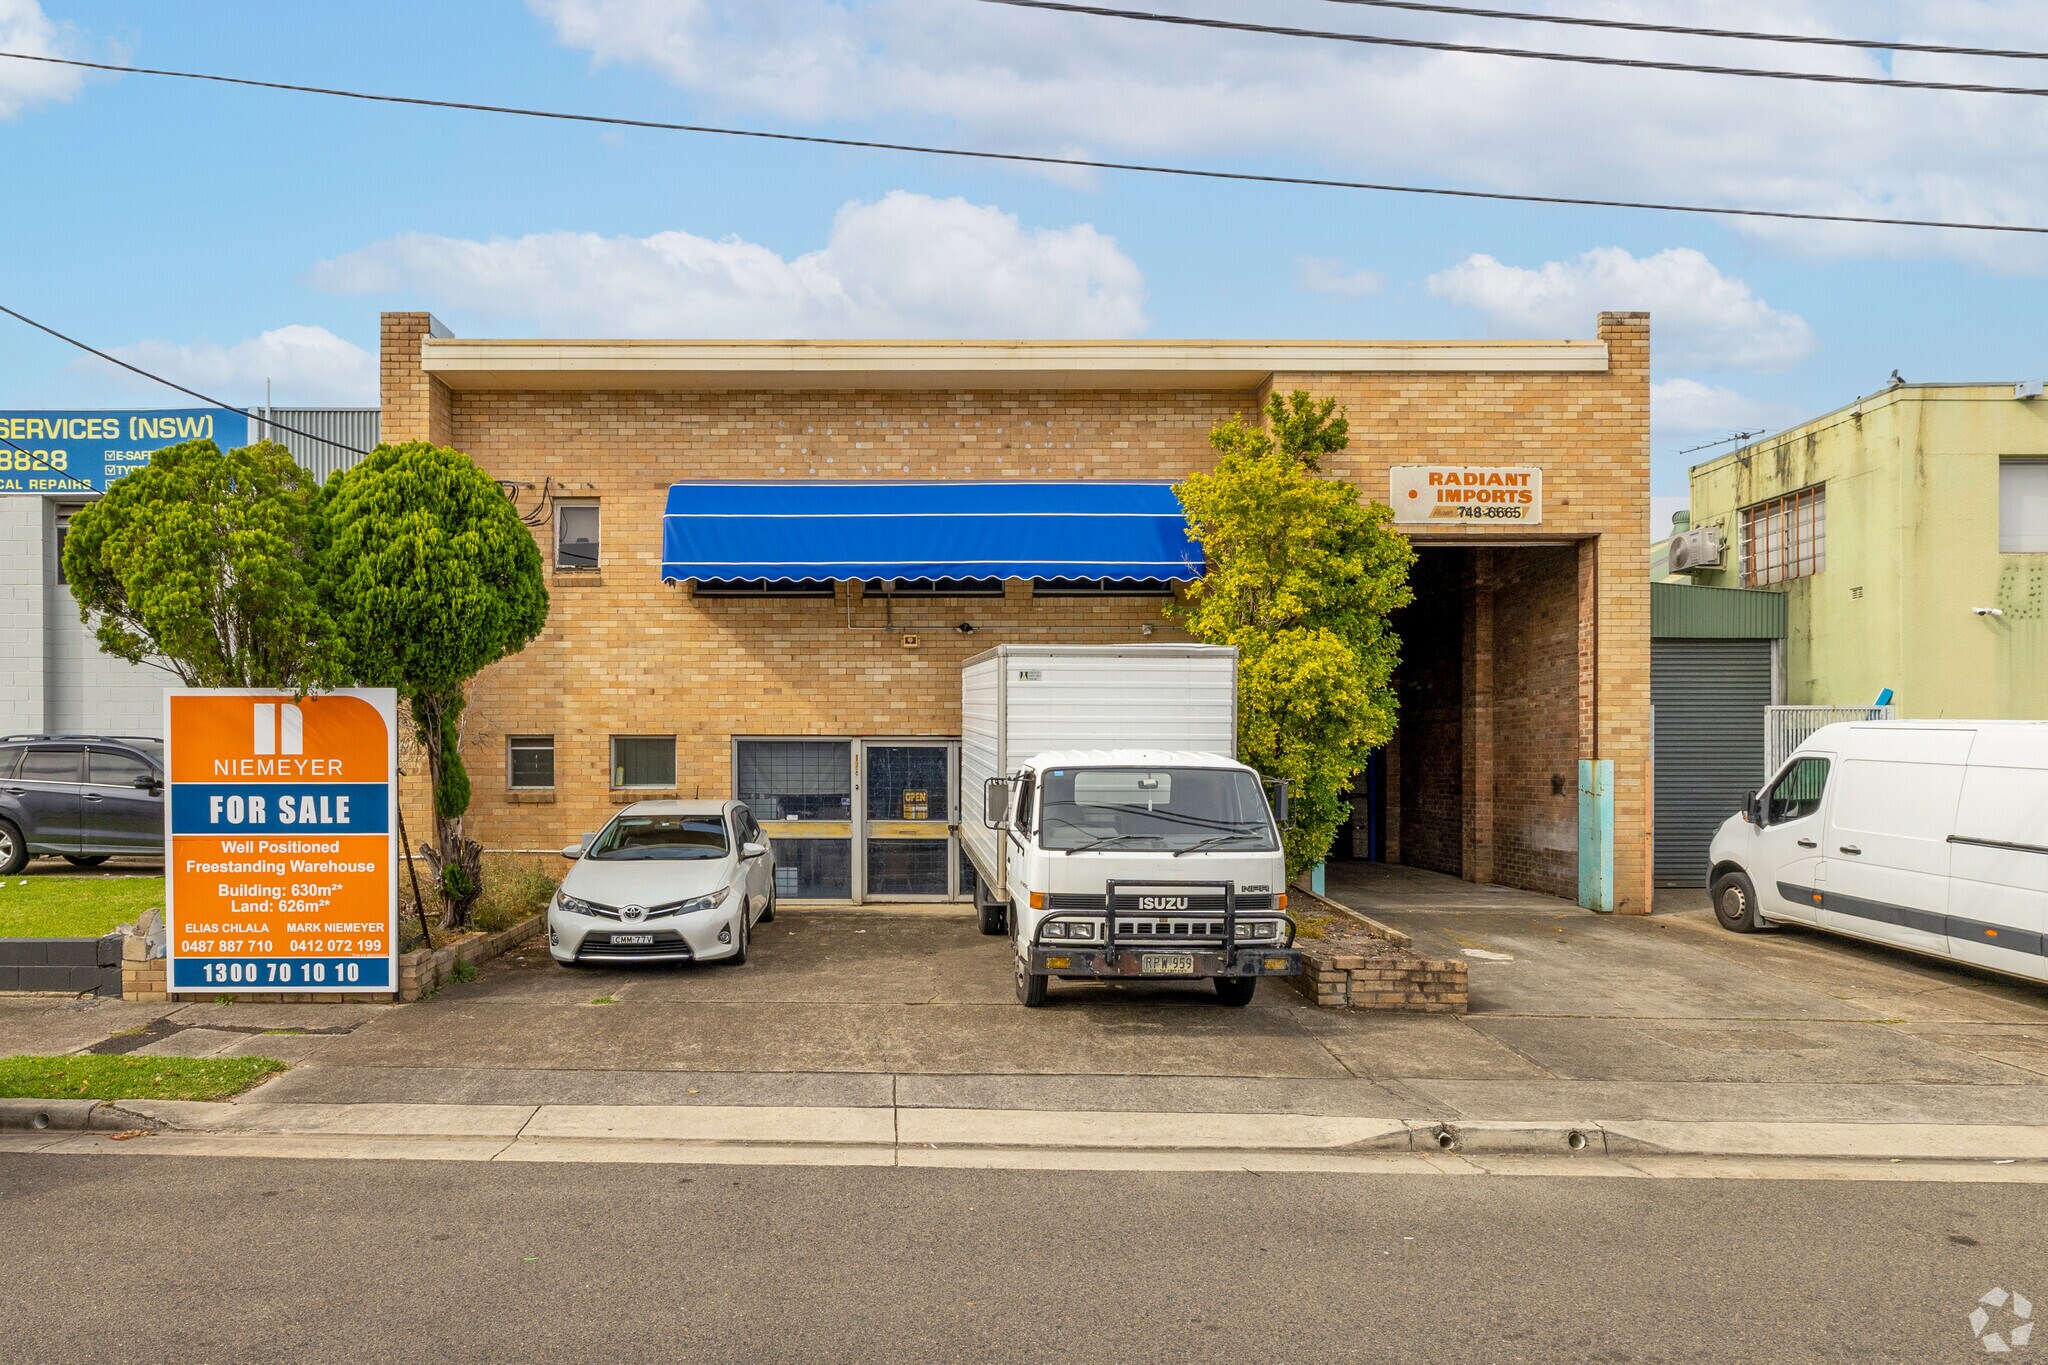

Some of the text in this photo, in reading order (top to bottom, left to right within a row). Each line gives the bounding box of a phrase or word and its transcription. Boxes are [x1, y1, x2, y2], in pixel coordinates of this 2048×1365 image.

[0, 415, 214, 440] SERVICES (NSW)
[29, 479, 92, 490] REPAIRS
[1428, 472, 1531, 486] RADIANT
[1437, 489, 1533, 504] IMPORTS
[213, 759, 344, 776] NIEMEYER
[905, 792, 926, 802] OPEN
[209, 795, 350, 825] FOR SALE
[221, 840, 340, 854] Well Positioned
[186, 859, 375, 876] Freestanding Warehouse
[218, 884, 286, 900] Building:
[1241, 885, 1270, 893] NPR
[231, 900, 274, 913] Land:
[1138, 897, 1189, 910] ISUZU
[185, 923, 270, 933] ELIAS CHLALA
[286, 922, 385, 933] MARK NIEMEYER
[181, 940, 273, 953] 0487 887 710
[289, 939, 382, 952] 0412 072 199
[203, 963, 360, 982] 1300 70 10 10
